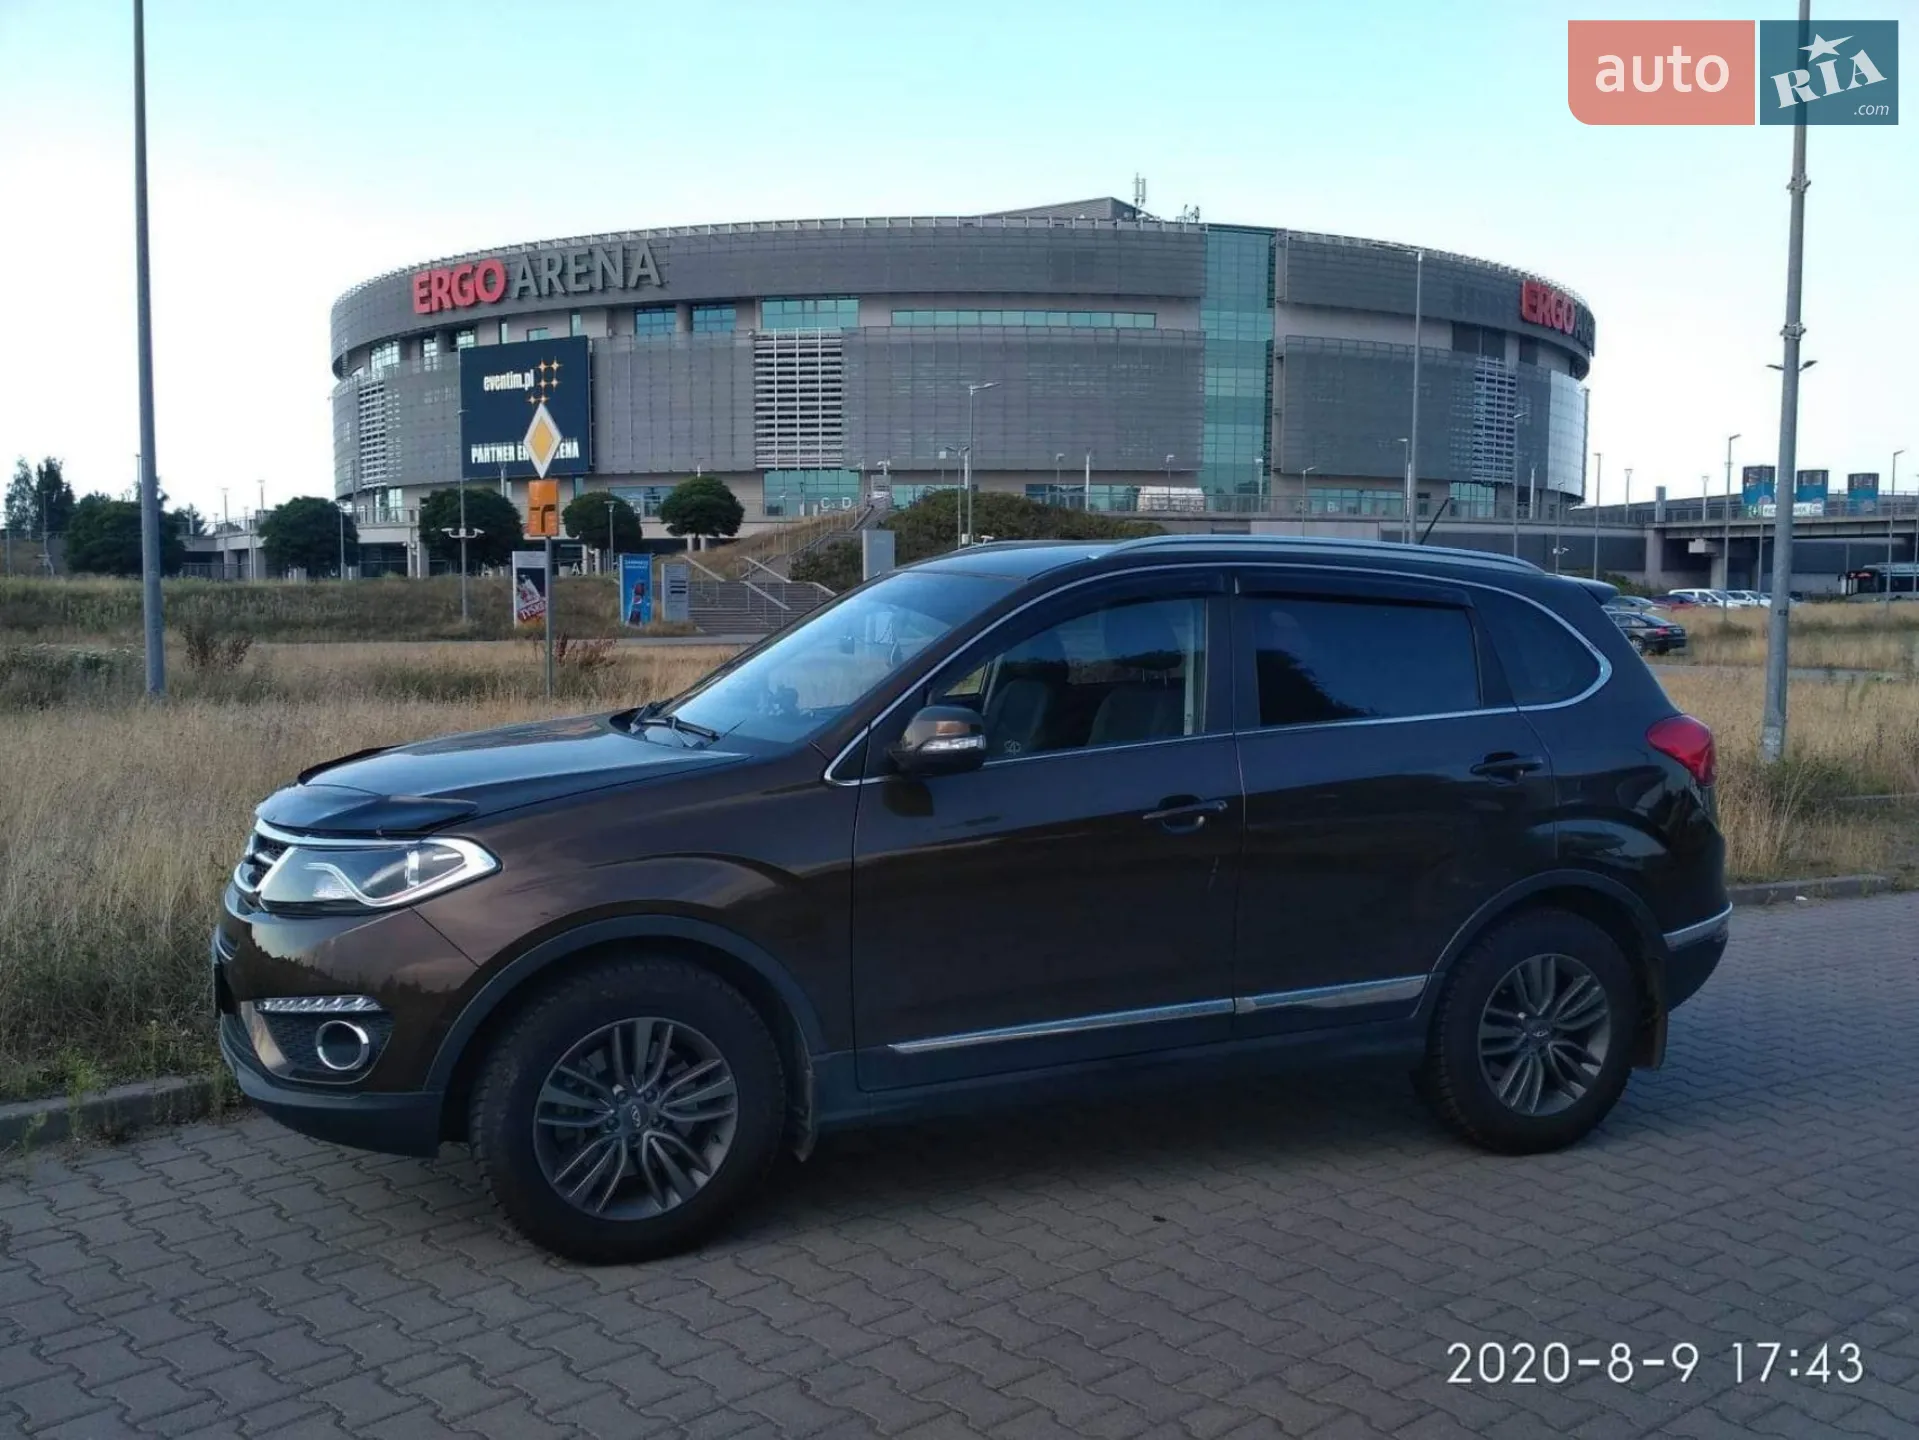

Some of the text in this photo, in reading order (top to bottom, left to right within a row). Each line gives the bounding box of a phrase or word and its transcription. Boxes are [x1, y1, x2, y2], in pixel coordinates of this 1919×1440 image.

[412, 244, 663, 314] ERGO ARENA
[1522, 279, 1576, 334] ERGO
[483, 369, 534, 391] eventim.pl
[471, 443, 515, 464] PARTNER
[842, 497, 853, 508] D
